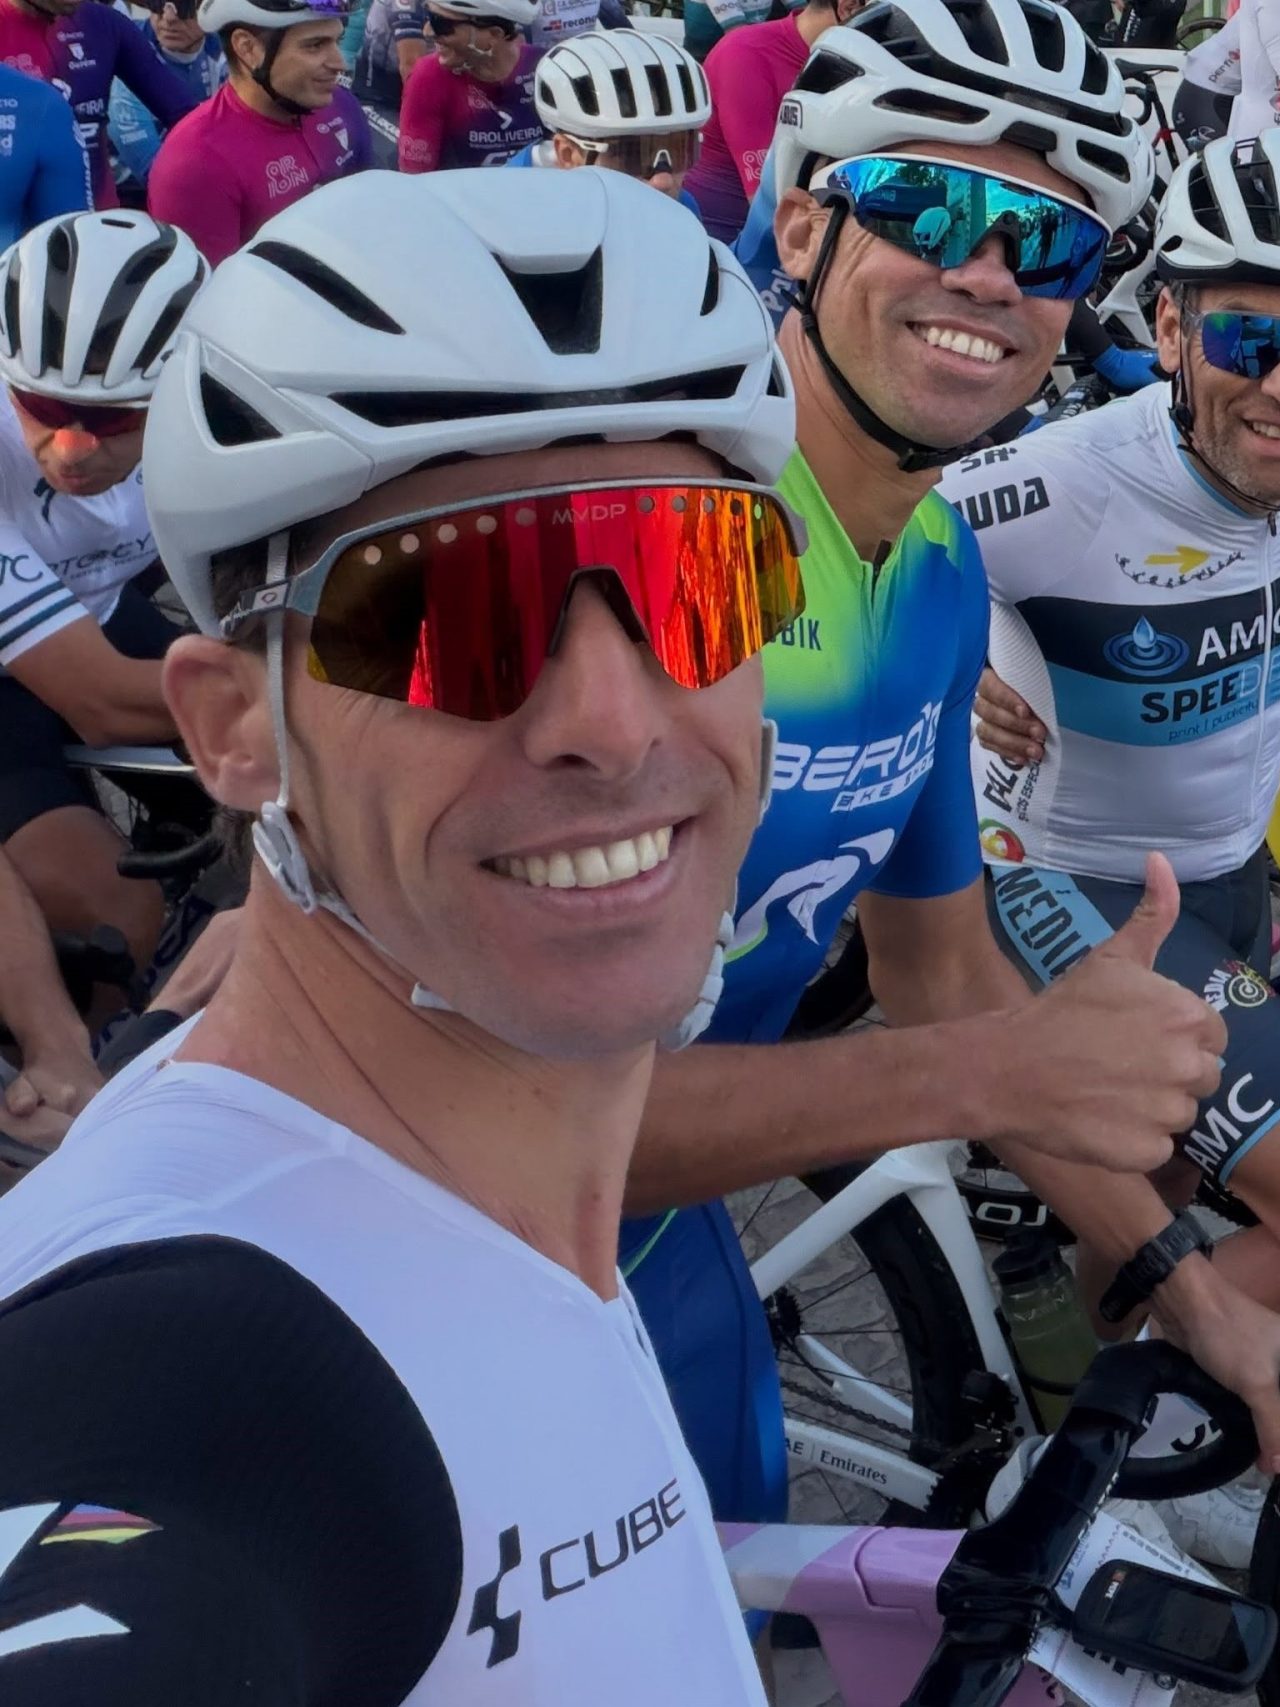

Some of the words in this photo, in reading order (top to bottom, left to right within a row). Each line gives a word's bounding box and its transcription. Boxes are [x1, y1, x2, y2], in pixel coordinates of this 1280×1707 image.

[469, 126, 543, 143] BROLIVEIRA
[551, 503, 627, 526] MVDP
[1183, 1071, 1275, 1177] AMC
[785, 1437, 805, 1456] AE
[819, 1449, 888, 1486] Emirates
[539, 1477, 687, 1602] CUBE
